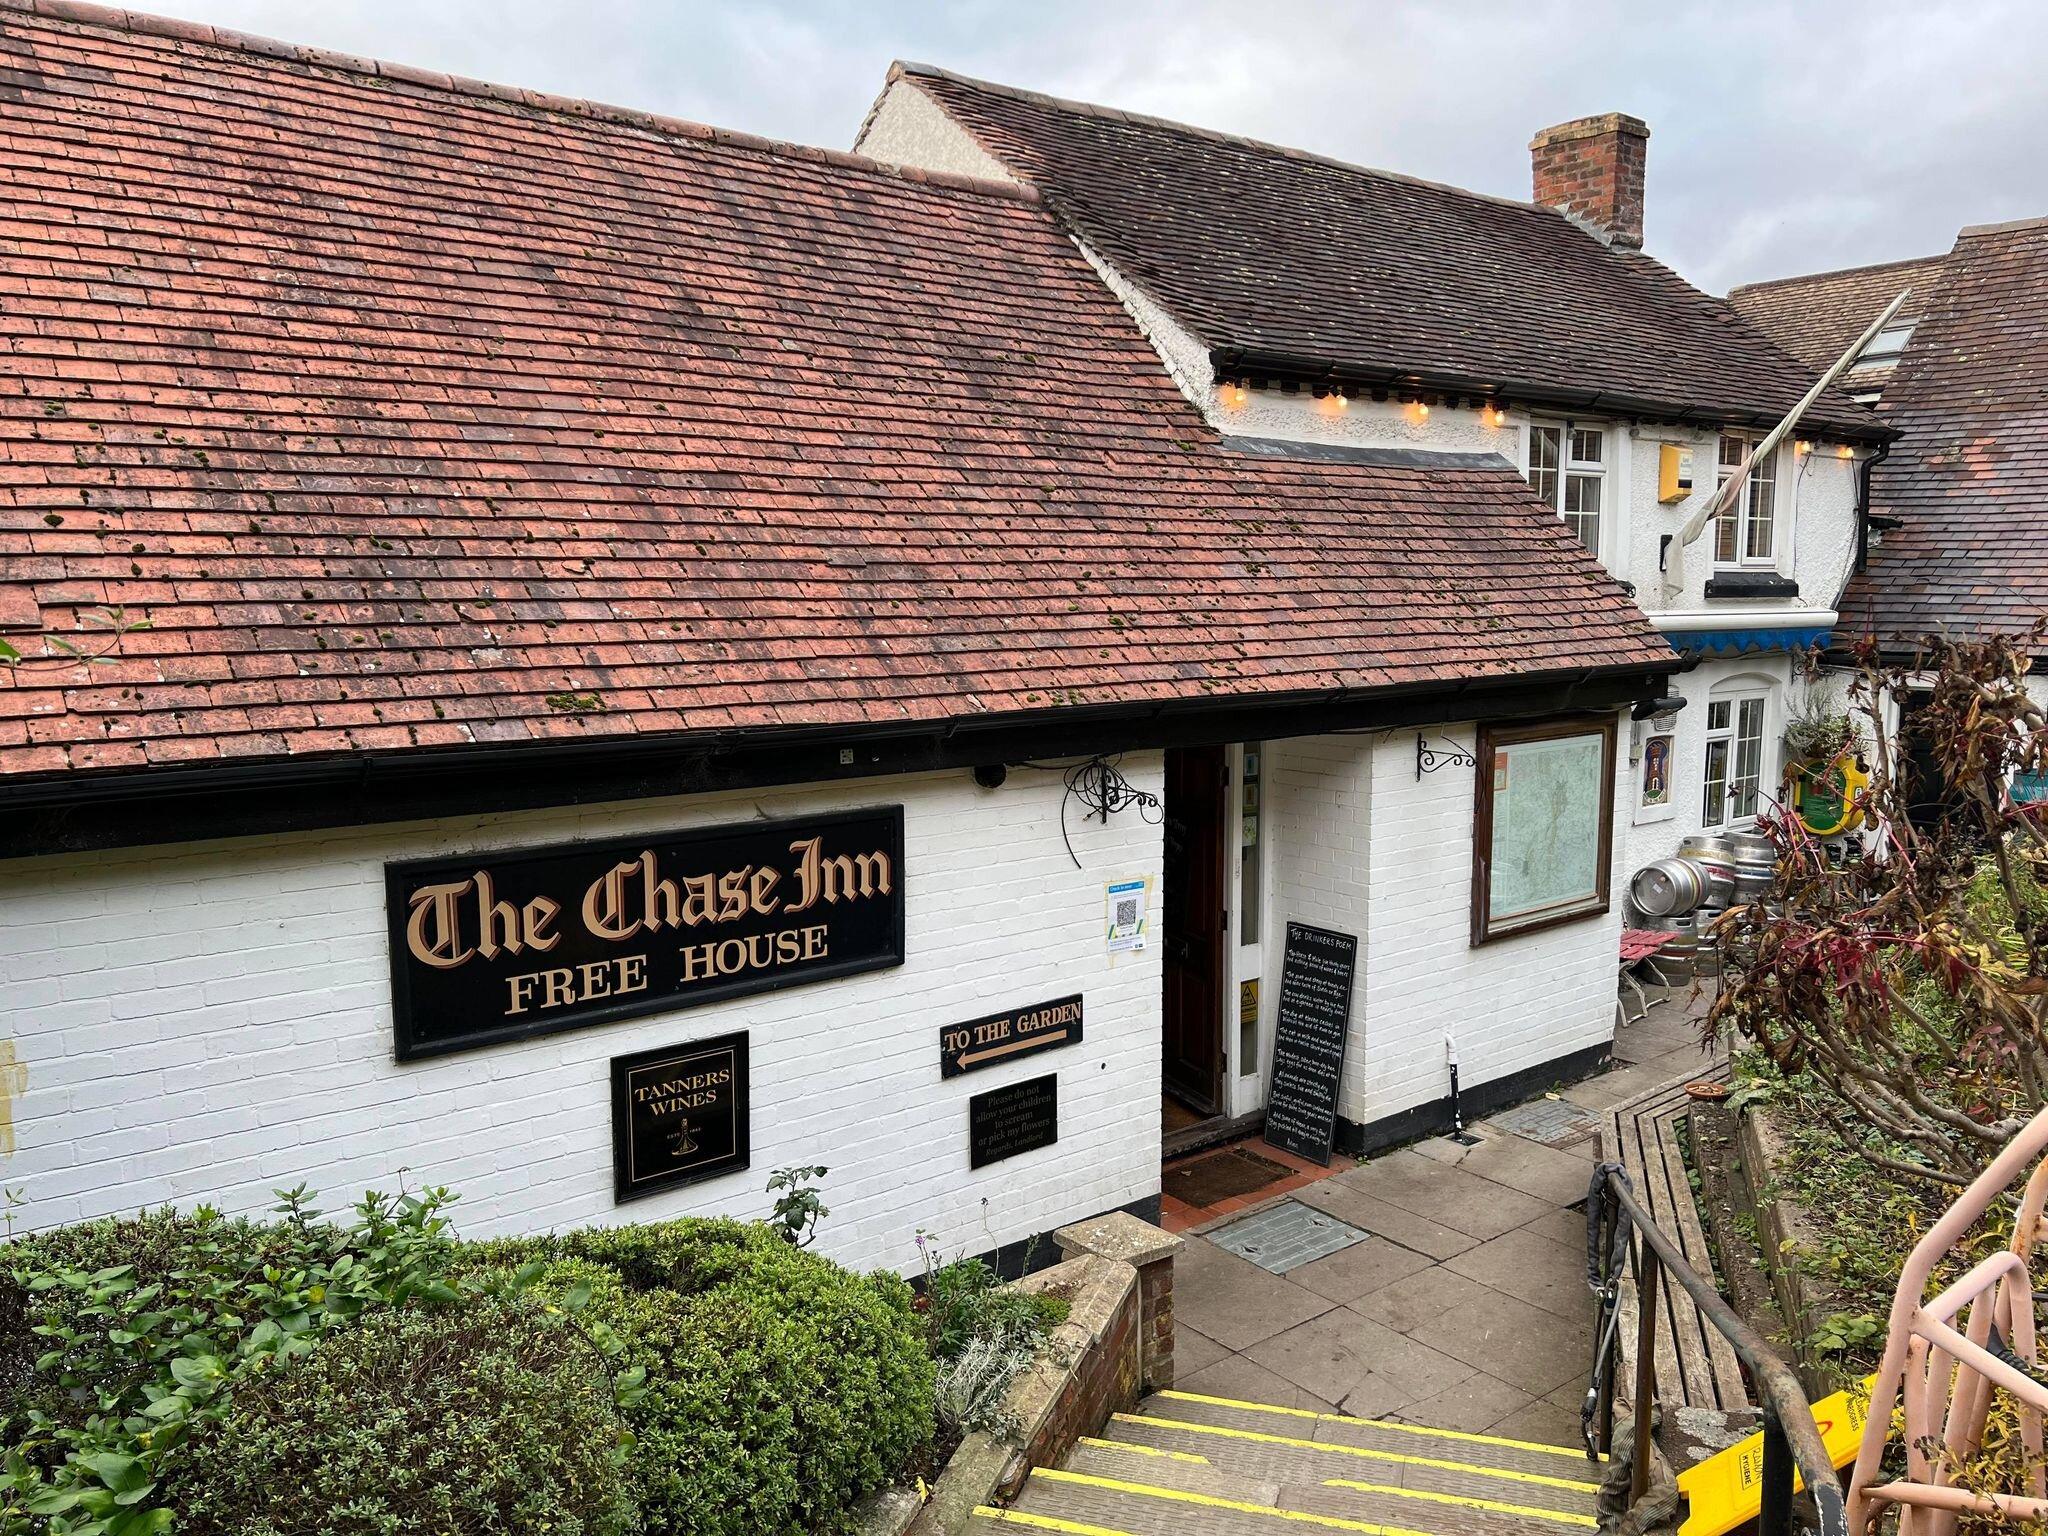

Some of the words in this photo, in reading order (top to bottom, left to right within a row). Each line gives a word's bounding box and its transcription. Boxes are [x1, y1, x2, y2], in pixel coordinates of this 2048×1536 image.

[408, 870, 561, 968] The
[582, 849, 780, 943] Chase
[785, 836, 894, 913] Inn
[1336, 940, 1351, 950] POEM
[504, 954, 647, 1016] FREE
[679, 924, 829, 982] HOUSE
[944, 1030, 970, 1052] TO
[974, 1019, 1010, 1046] THE
[1017, 1002, 1082, 1033] GARDEN
[634, 1069, 730, 1102] TANNERS
[988, 1094, 1013, 1108] Please
[1014, 1089, 1025, 1100] do
[1026, 1085, 1040, 1095] not
[649, 1090, 717, 1118] WINES
[975, 1110, 997, 1123] allow
[999, 1105, 1018, 1118] your
[1019, 1094, 1051, 1109] children
[978, 1137, 987, 1146] or
[988, 1130, 1005, 1145] pick
[1008, 1127, 1020, 1137] my
[1022, 1118, 1050, 1133] flowers
[995, 1120, 1003, 1129] to
[1004, 1111, 1033, 1126] scream
[1742, 1455, 1751, 1485] HYGIENE
